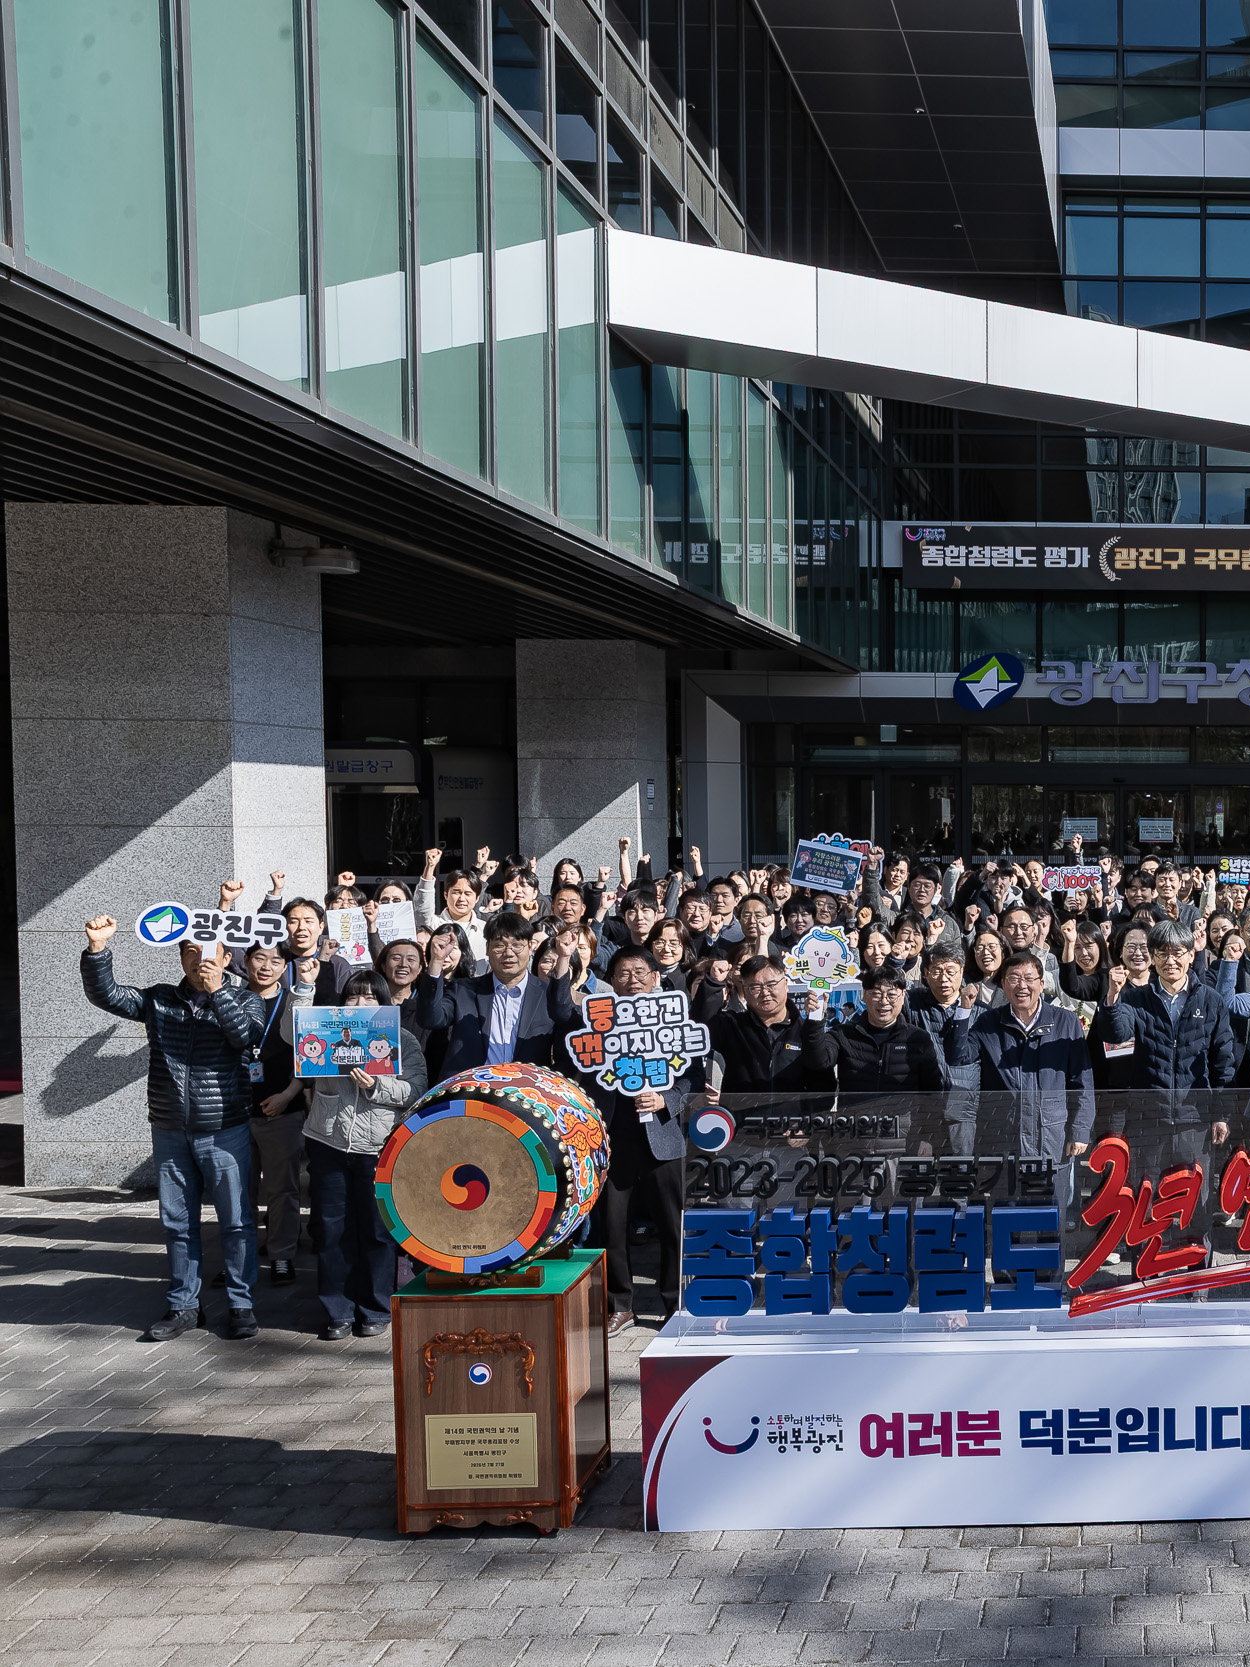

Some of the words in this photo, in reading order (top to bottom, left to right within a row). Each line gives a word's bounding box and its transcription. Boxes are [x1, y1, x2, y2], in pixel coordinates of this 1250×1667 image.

[921, 545, 1037, 568] 종합청렴도
[1044, 546, 1091, 568] 평가
[1114, 547, 1186, 570] 광진구
[1218, 872, 1250, 885] 여러분
[191, 913, 284, 945] 광진구
[320, 1020, 359, 1029] 국민권익의
[360, 1020, 369, 1028] 날
[572, 1031, 653, 1066] 꺾이지
[658, 1026, 704, 1052] 않는
[615, 1057, 667, 1090] 청렴
[743, 1115, 901, 1140] 국민권익위원회
[686, 1154, 890, 1199] 2023-2025
[897, 1154, 1058, 1198] 공공기관
[682, 1205, 1062, 1317] 종합청렴도
[1067, 1133, 1208, 1289] 3년
[444, 1427, 465, 1435] 제14회
[507, 1426, 520, 1434] 기념
[766, 1413, 803, 1430] 소통하며
[804, 1413, 843, 1430] 발전하는
[860, 1410, 1001, 1458] 여러분
[766, 1427, 844, 1454] 행복광진
